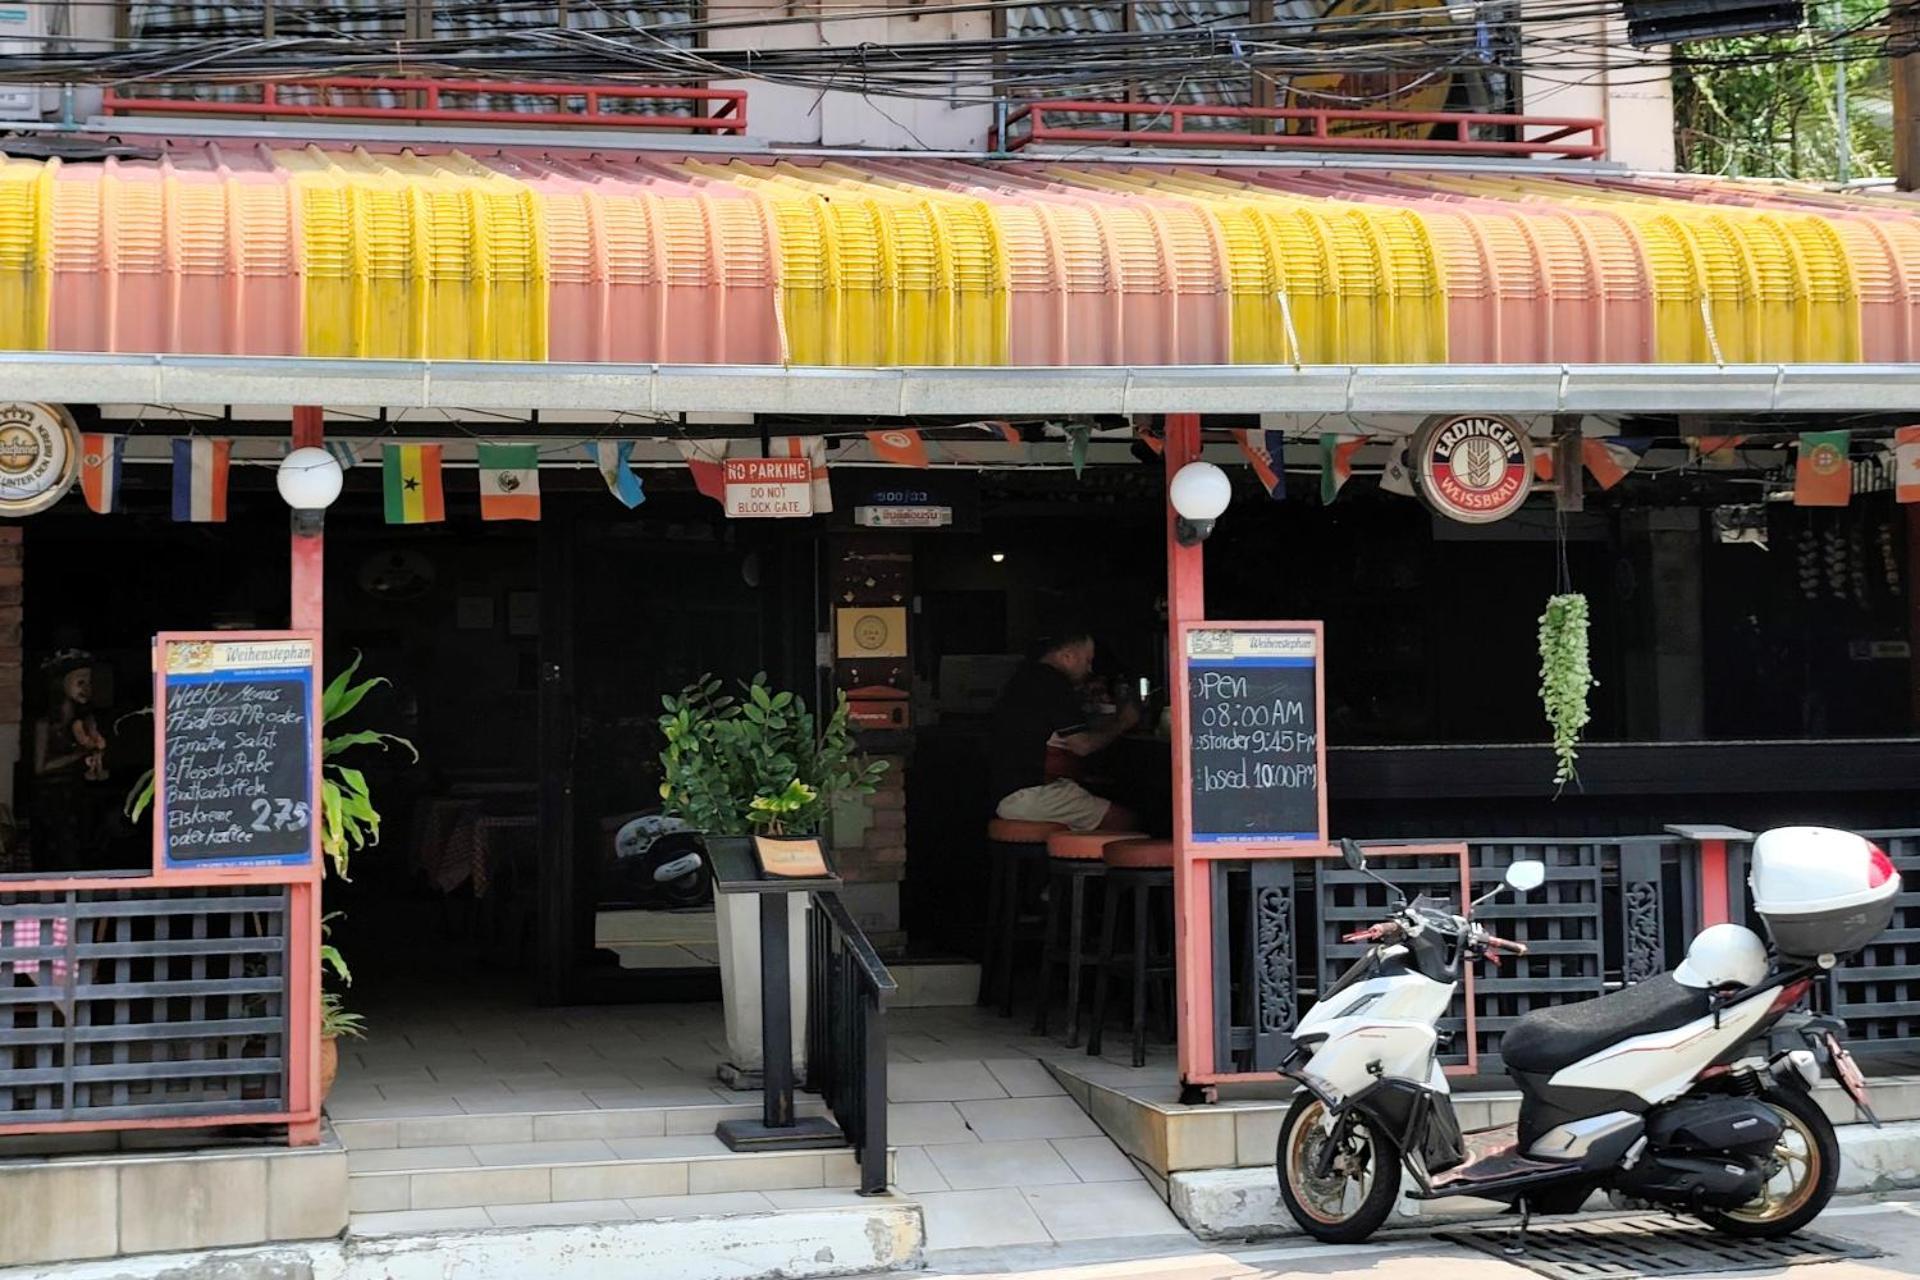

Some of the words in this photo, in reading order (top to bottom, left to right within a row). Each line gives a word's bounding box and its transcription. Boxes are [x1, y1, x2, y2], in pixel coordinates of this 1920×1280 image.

[1435, 419, 1520, 458] ERDINGER
[727, 462, 746, 480] NO
[749, 461, 806, 479] PARKING
[750, 487, 765, 498] DO
[767, 486, 786, 498] NOT
[738, 501, 770, 513] BLOCK
[775, 501, 799, 513] GATE
[225, 645, 311, 663] Weihenstephan
[251, 798, 310, 832] 275
